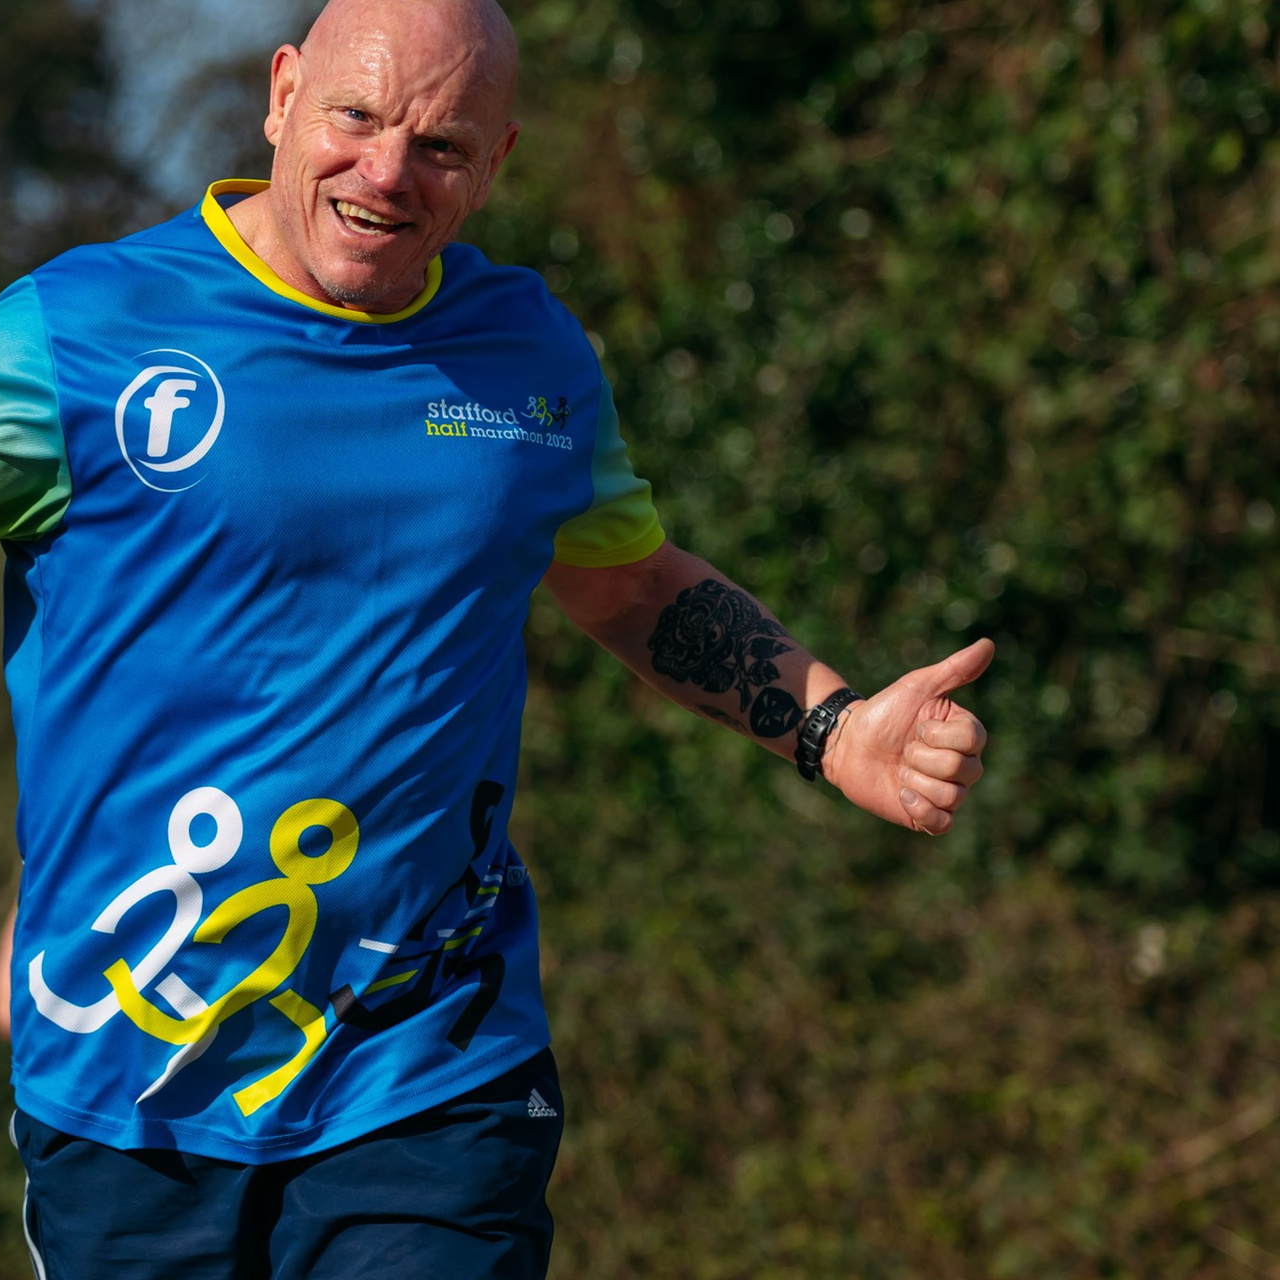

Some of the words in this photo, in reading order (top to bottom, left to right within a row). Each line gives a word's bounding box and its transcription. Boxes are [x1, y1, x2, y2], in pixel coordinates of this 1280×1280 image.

[143, 378, 197, 458] f
[427, 398, 520, 425] stafford
[425, 419, 468, 437] half
[470, 426, 543, 444] marathon
[546, 432, 573, 450] 2023
[528, 1106, 557, 1117] adidas
